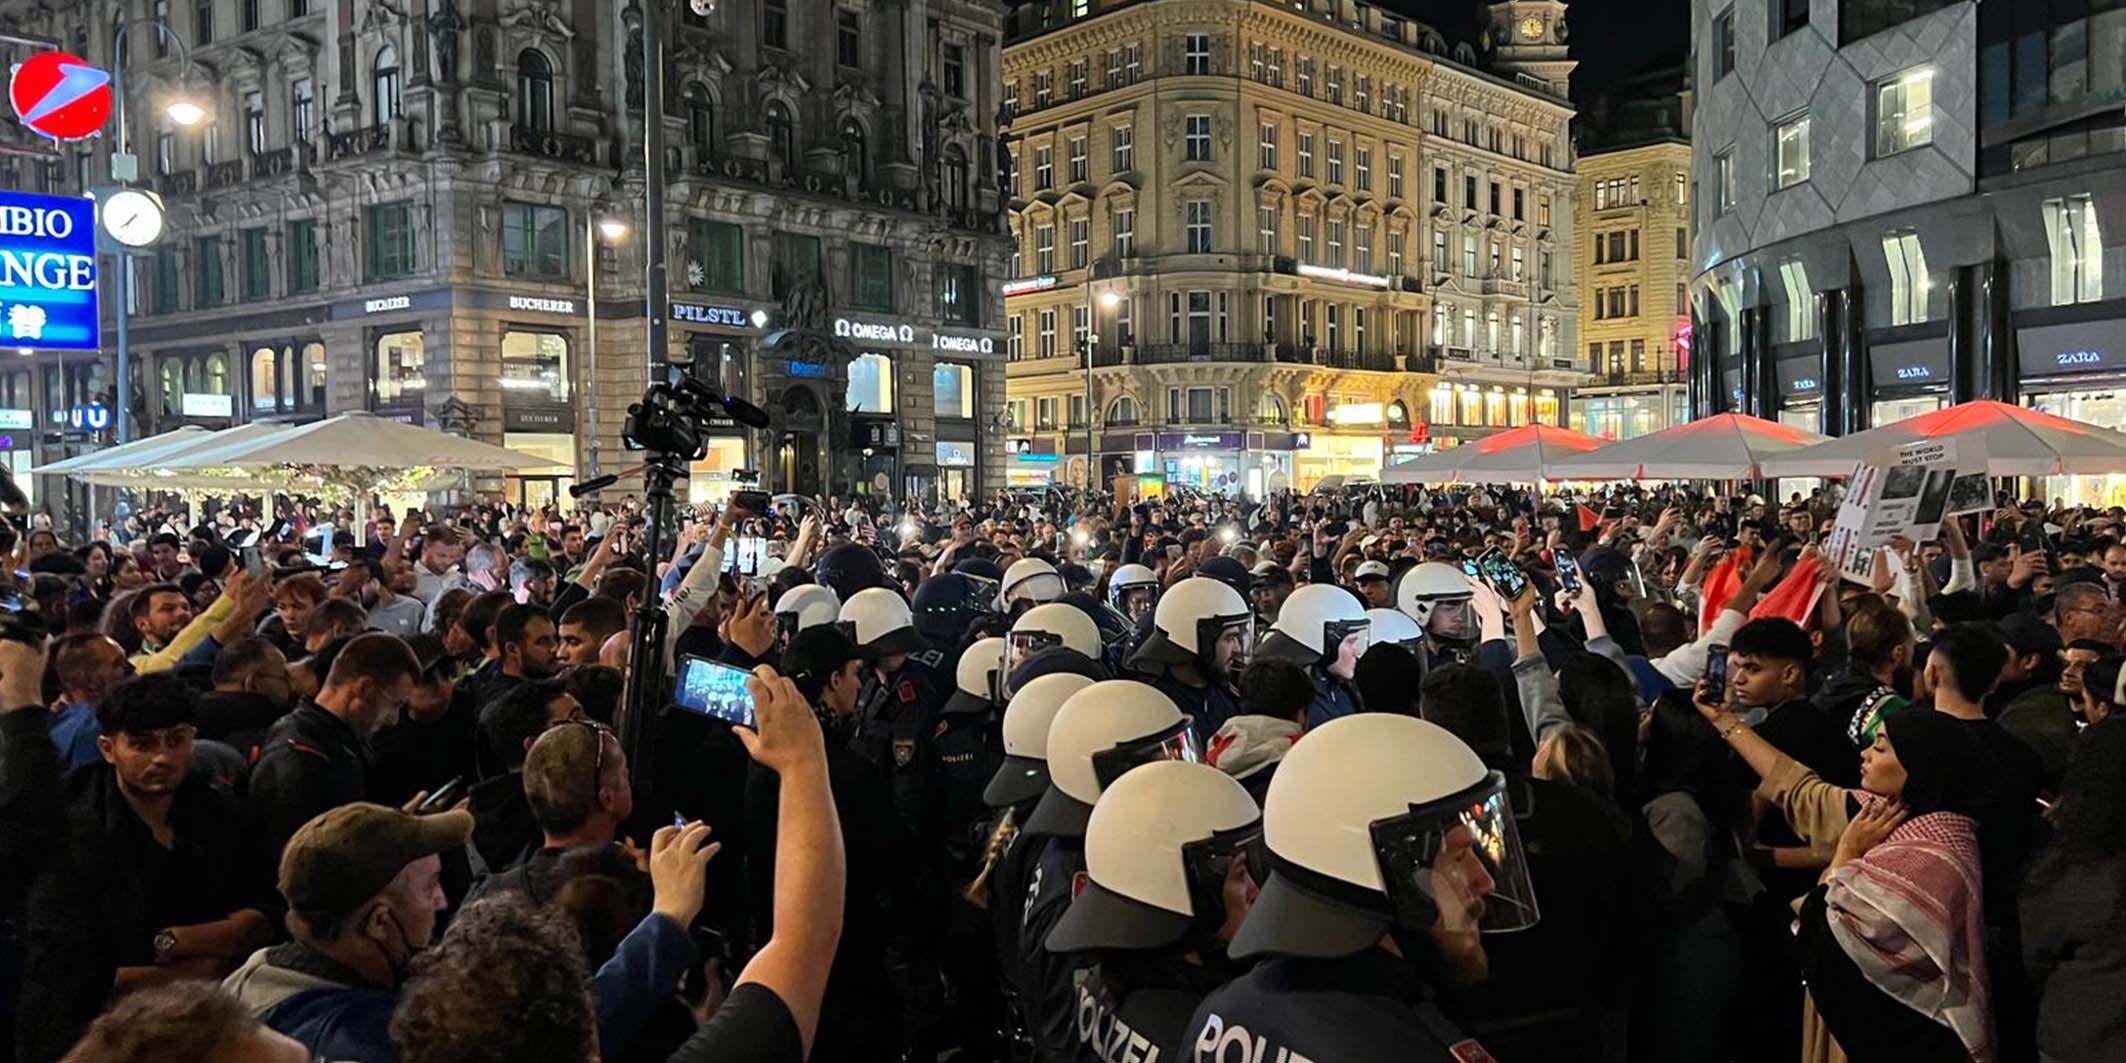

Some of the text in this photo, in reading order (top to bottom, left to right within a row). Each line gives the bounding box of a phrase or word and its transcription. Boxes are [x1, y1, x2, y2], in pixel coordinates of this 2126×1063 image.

[509, 297, 573, 313] BUCHERER
[0, 303, 46, 339] 替
[673, 303, 745, 325] PILSTL
[851, 323, 897, 341] OMEGA
[940, 336, 979, 352] OMEGA
[2056, 351, 2100, 364] ZARA
[1897, 367, 1929, 379] ZARA
[87, 408, 107, 429] U
[1915, 445, 1944, 457] WORLD
[1924, 453, 1945, 463] STOP
